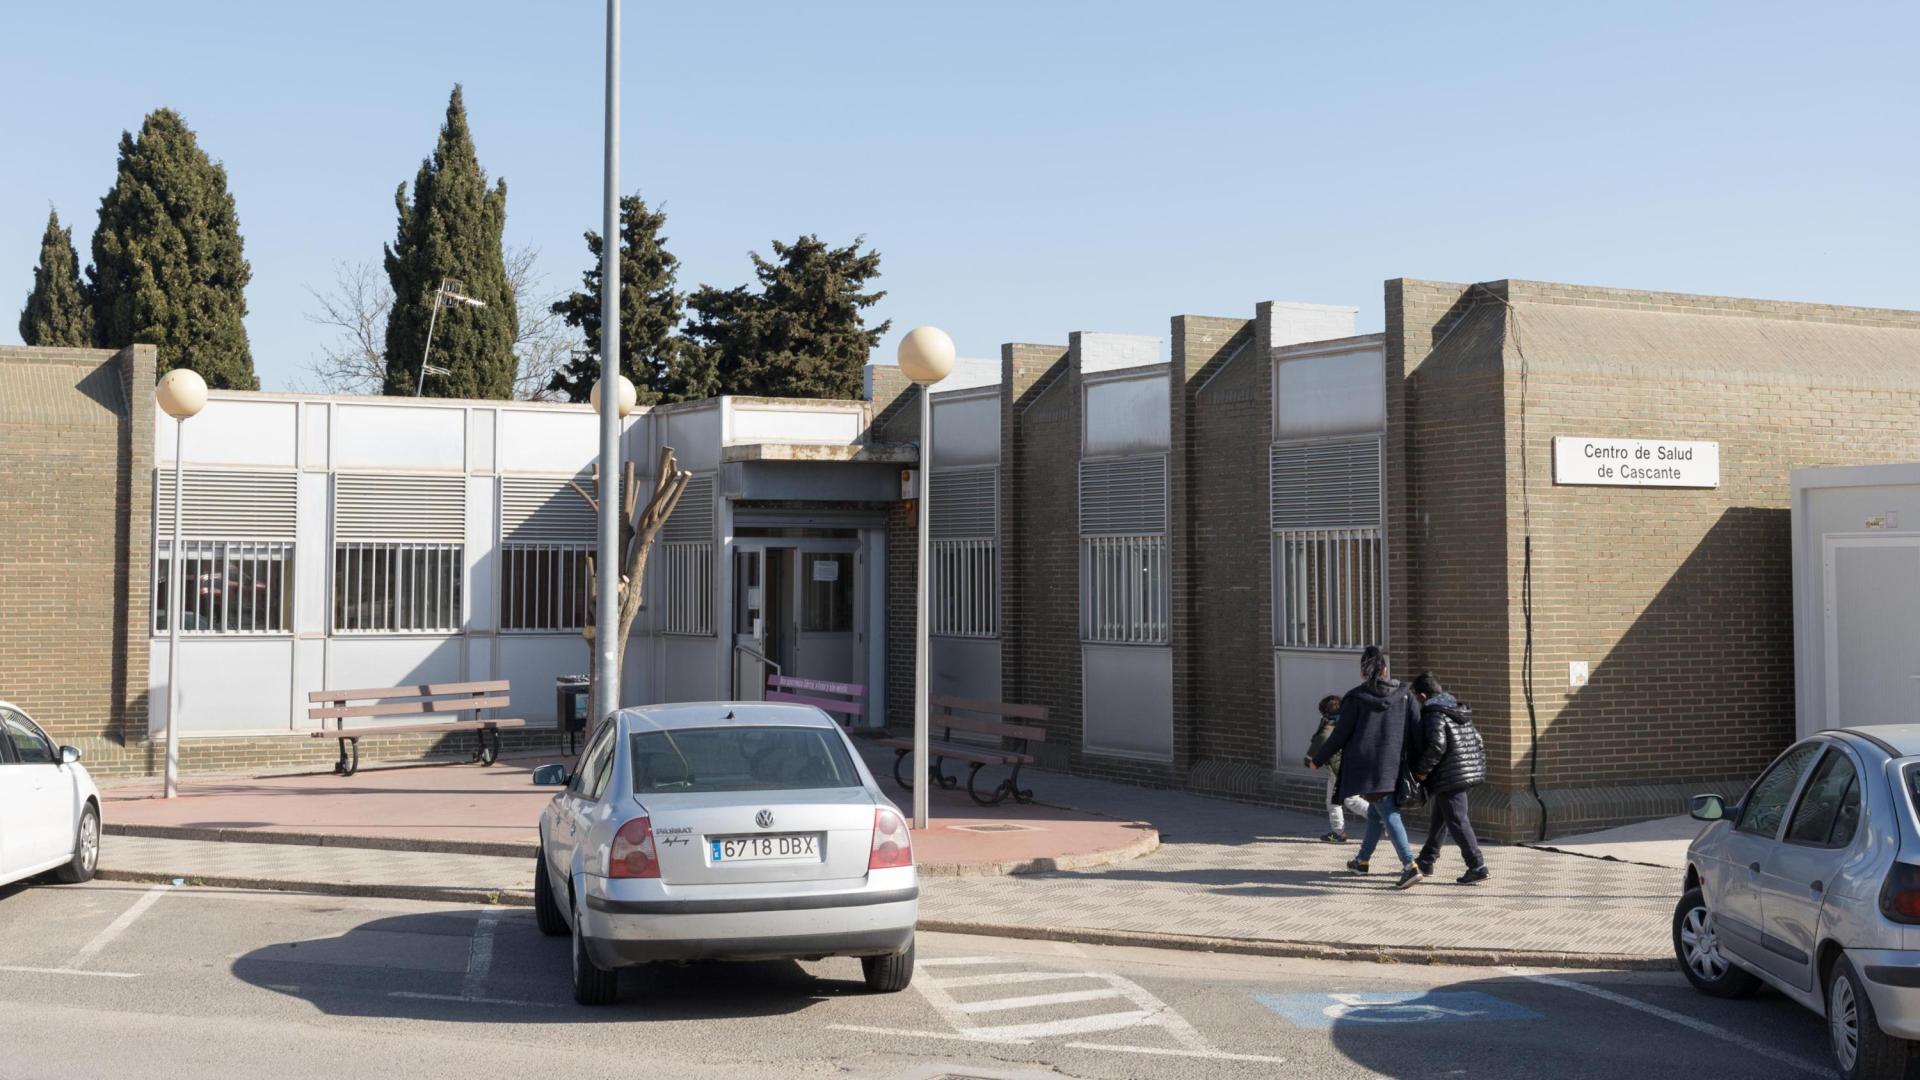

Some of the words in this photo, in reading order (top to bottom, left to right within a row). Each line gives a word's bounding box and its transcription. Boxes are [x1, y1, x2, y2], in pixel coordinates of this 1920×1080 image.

[1584, 443, 1628, 459] Centro
[1635, 446, 1650, 460] de
[1657, 446, 1693, 461] Salud
[1597, 464, 1613, 478] de
[1620, 464, 1681, 479] Cascante
[724, 838, 772, 857] 6718
[779, 837, 815, 855] DBX
